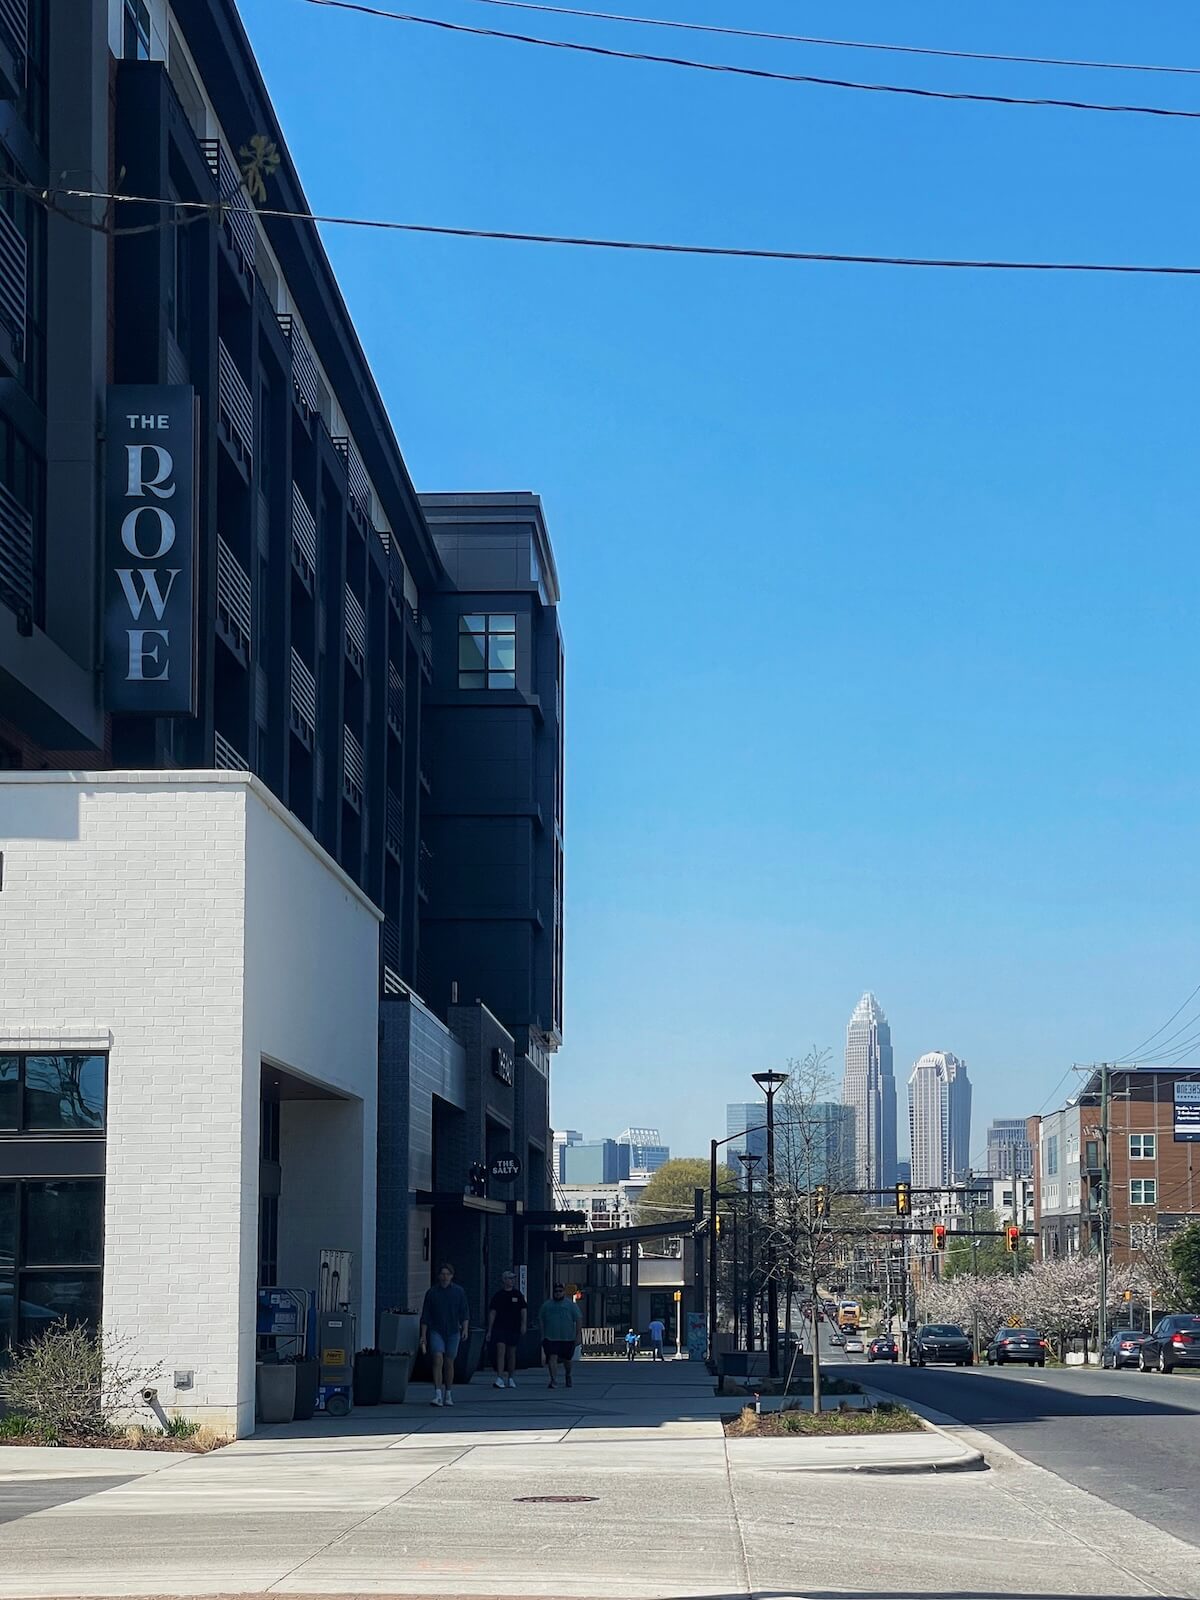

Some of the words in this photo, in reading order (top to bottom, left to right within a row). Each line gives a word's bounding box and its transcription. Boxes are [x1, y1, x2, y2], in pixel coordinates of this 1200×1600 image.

[126, 414, 170, 429] THE
[114, 444, 182, 681] ROWE
[492, 1166, 519, 1174] SALTY
[581, 1327, 615, 1345] WEALTH
